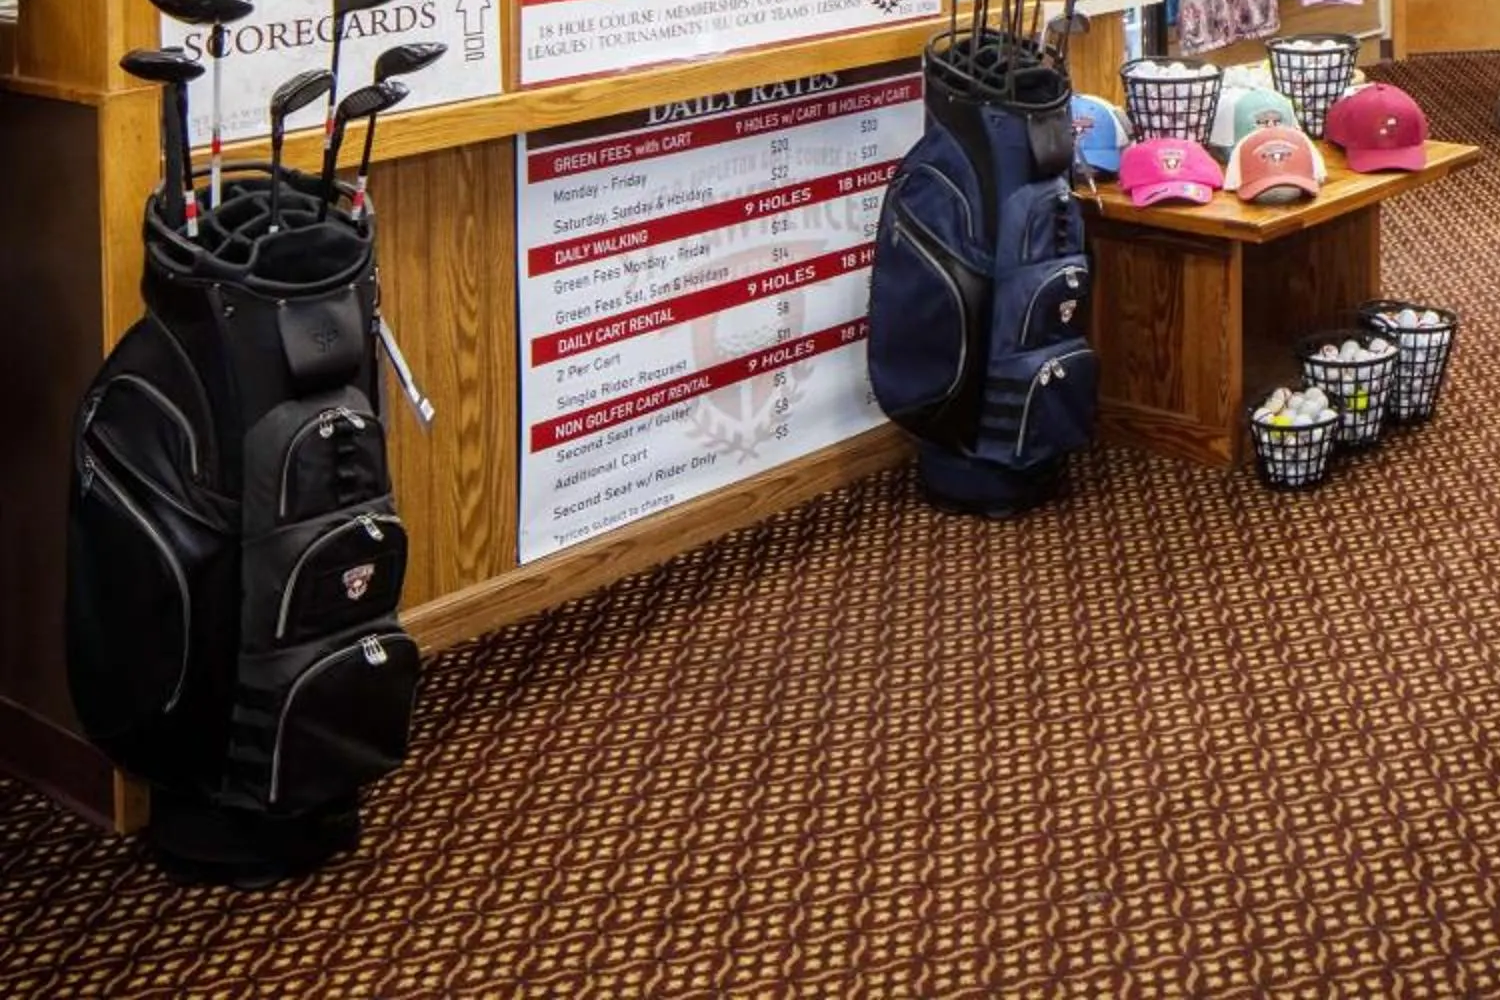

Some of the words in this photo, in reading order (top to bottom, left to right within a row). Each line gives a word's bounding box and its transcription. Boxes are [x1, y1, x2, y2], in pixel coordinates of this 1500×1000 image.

[527, 38, 588, 61] LEAGUES
[599, 22, 703, 48] TOURNAMENTS
[539, 25, 554, 39] 18
[558, 17, 595, 37] HOLE
[598, 9, 654, 30] COURSE
[645, 89, 739, 125] DAILY
[749, 73, 839, 105] RATES
[553, 151, 597, 173] GREEN
[600, 144, 632, 163] FEES
[635, 140, 660, 155] with
[662, 131, 693, 150] CART
[735, 120, 742, 135] 9
[743, 111, 779, 132] HOLES
[797, 103, 823, 122] CART
[839, 93, 872, 113] HOLES
[886, 85, 911, 103] CART
[553, 184, 599, 204] Monday
[611, 173, 648, 191] Friday
[555, 242, 590, 265] DAILY
[590, 229, 649, 255] WALKING
[743, 202, 755, 216] 9
[759, 187, 812, 211] HOLES
[838, 177, 853, 191] 18
[856, 165, 898, 187] HOLE
[612, 203, 653, 221] Sunday
[553, 275, 591, 295] Green
[593, 267, 621, 284] Fees
[555, 304, 591, 325] Green
[595, 296, 622, 313] Fees
[557, 332, 593, 354] DAILY
[595, 320, 628, 343] CART
[629, 307, 675, 331] RENTAL
[747, 283, 757, 297] 9
[761, 264, 817, 293] HOLES
[840, 253, 857, 269] 18
[556, 370, 565, 383] 2
[567, 361, 591, 378] Per
[593, 353, 621, 372] Cart
[555, 418, 583, 440] NON
[585, 401, 634, 430] GOLFER
[635, 388, 667, 413] CART
[667, 375, 712, 401] RENTAL
[748, 359, 757, 373] 9
[761, 339, 816, 369] HOLES
[557, 389, 597, 411] Single
[601, 376, 635, 397] Rider
[556, 438, 603, 463] Second
[606, 425, 635, 446] Seat
[553, 494, 601, 521] Second
[604, 480, 633, 502] Seat
[635, 472, 653, 489] w/
[655, 463, 688, 482] Rider
[691, 452, 718, 470] Only
[554, 458, 618, 491] Additional
[621, 448, 649, 468] Cart
